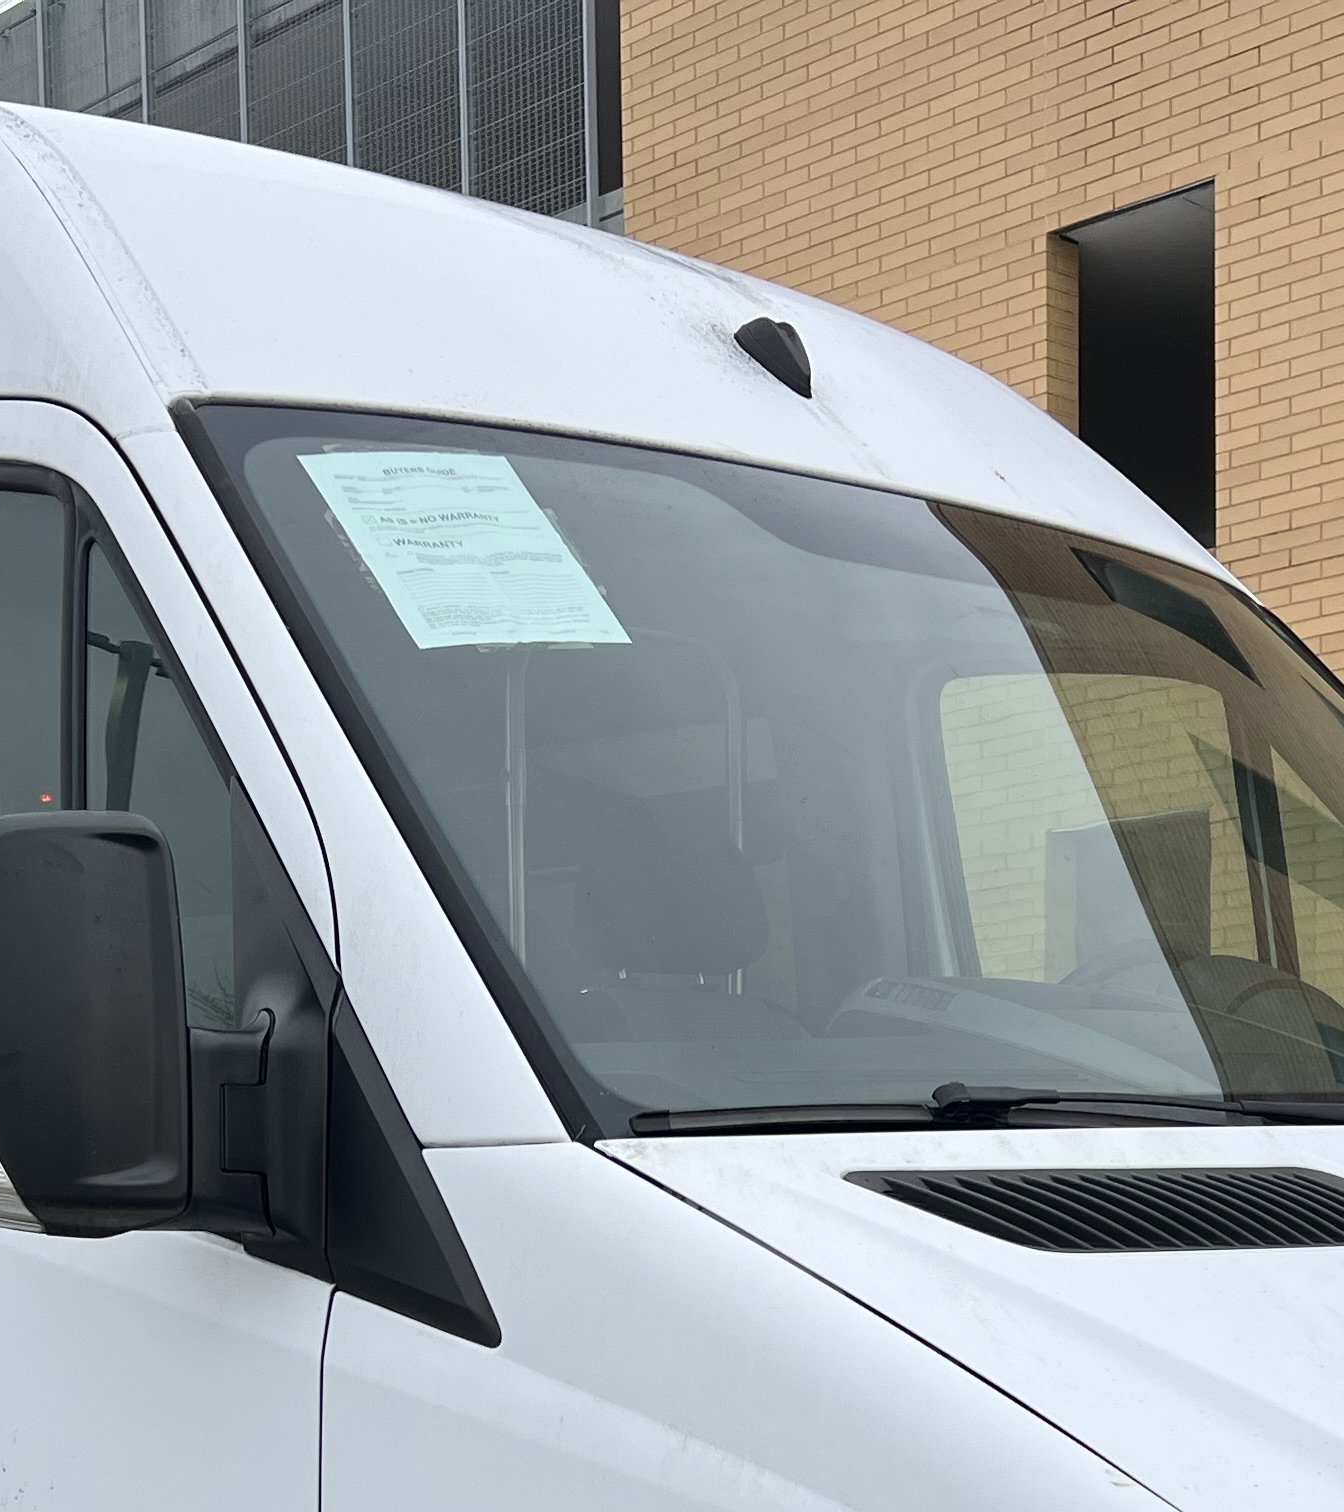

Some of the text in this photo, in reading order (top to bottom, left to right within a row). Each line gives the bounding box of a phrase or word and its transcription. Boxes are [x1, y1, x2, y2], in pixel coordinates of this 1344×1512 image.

[382, 466, 425, 477] BUYERS
[380, 515, 395, 524] AS
[397, 517, 407, 526] IS
[419, 515, 437, 525] NO
[438, 511, 500, 523] WARRANTY
[392, 537, 464, 549] WARRANTY
